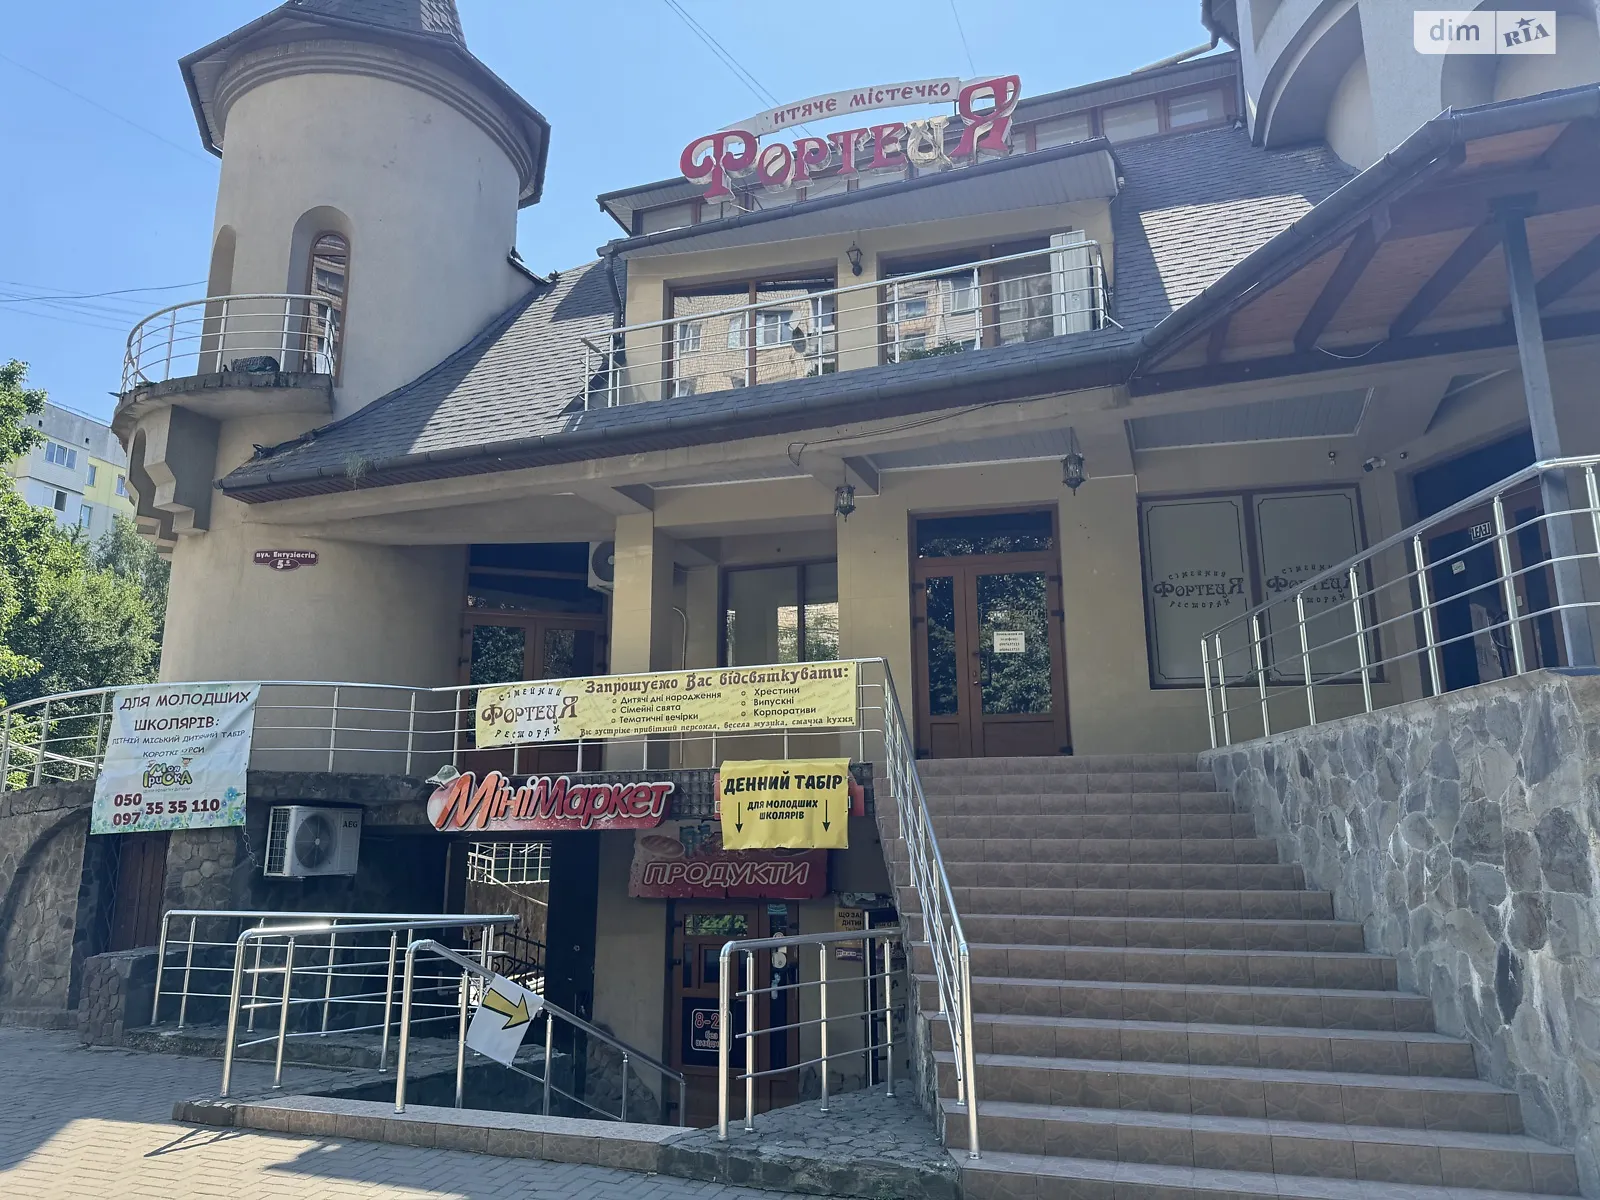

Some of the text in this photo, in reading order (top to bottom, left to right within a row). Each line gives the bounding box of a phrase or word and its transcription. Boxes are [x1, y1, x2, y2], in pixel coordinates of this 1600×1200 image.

[273, 551, 316, 559] Ентузіастів
[585, 666, 849, 696] Запрошуємо Вас відсвяткувати:
[620, 691, 722, 705] Дитячі дні народження
[754, 687, 800, 697] Хрестини
[119, 691, 251, 711] ДЛЯ МОЛОДШИХ
[753, 697, 795, 707] Випускні
[620, 703, 681, 714] Сімейні свята
[753, 706, 816, 718] Корпоративи
[134, 716, 220, 732] ШКОЛЯРІВ:
[619, 712, 699, 724] Тематичні вечірки
[723, 770, 843, 795] ДЕННИЙ ТАБІР
[113, 793, 143, 807] 050
[145, 798, 220, 815] 35 35 110
[747, 799, 819, 811] ДЛЯ МОЛОДШИХ
[112, 812, 141, 826] 097
[759, 809, 805, 821] ШКОЛЯРІВ
[342, 820, 358, 828] AEG
[643, 861, 810, 888] ПРОДУКТИ
